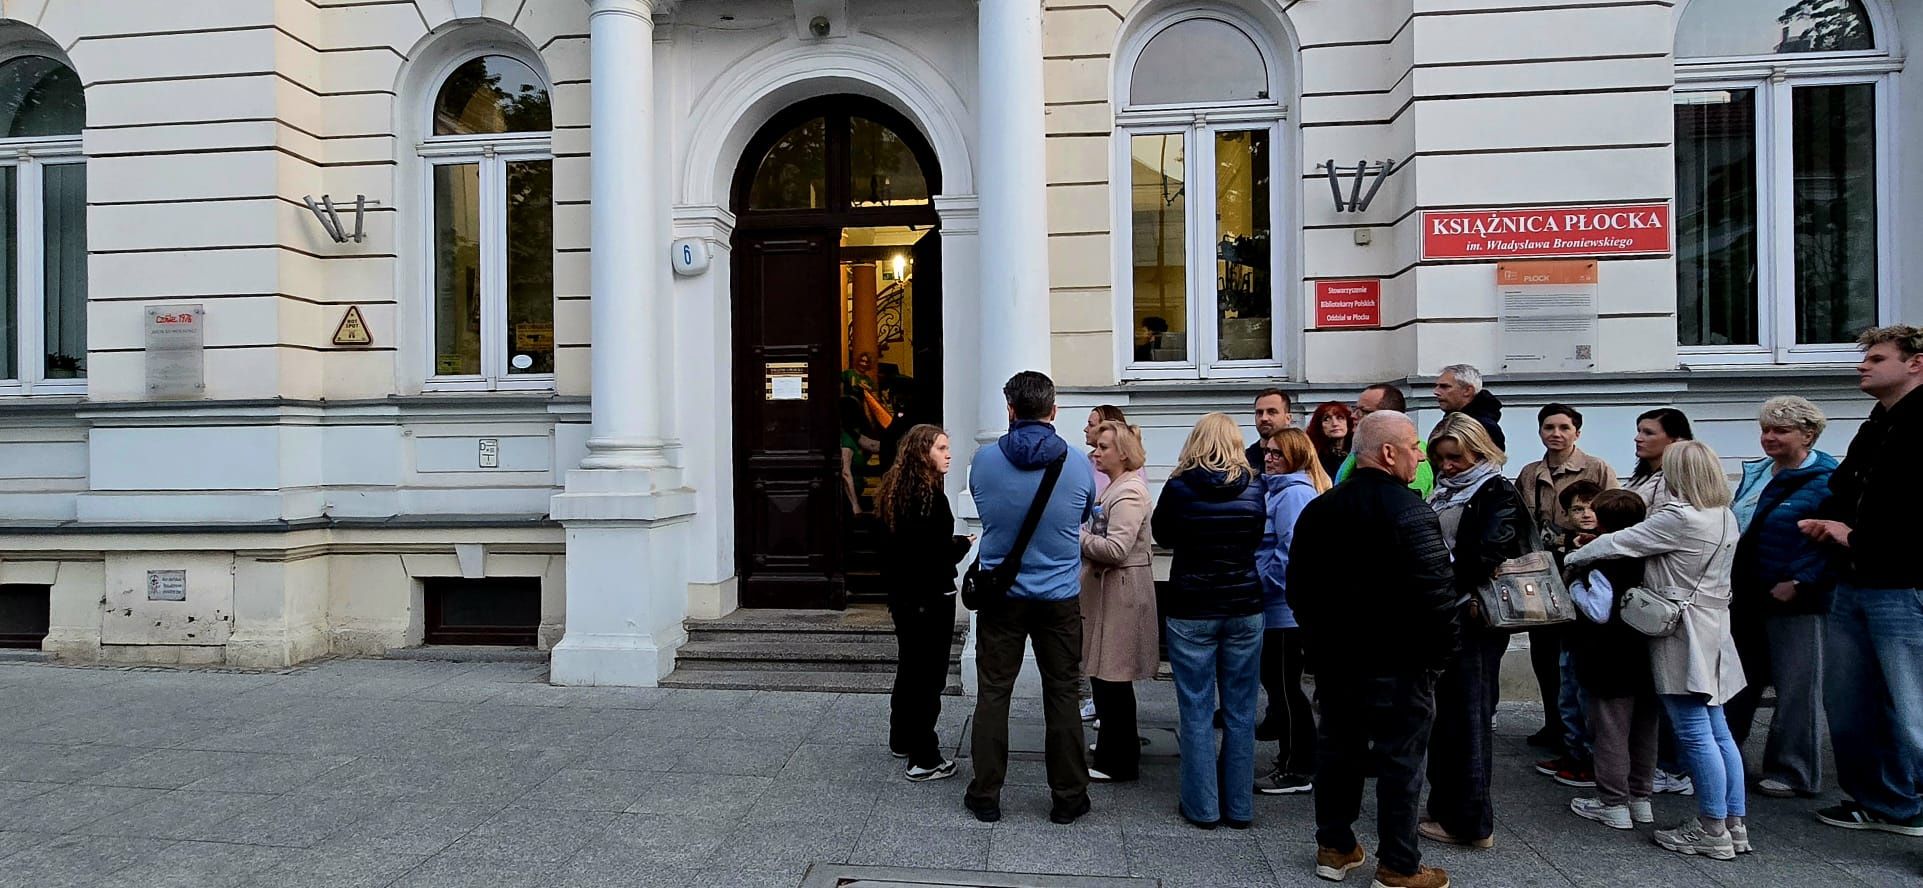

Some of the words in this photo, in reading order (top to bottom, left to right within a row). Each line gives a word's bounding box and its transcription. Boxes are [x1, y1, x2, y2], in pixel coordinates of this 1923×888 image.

[1432, 213, 1560, 238] KSIĄŻNICA
[1565, 211, 1663, 231] PŁOCKA
[1466, 240, 1483, 251] im.
[1486, 238, 1550, 252] Władysława
[1553, 236, 1634, 250] Broniewskiego
[683, 244, 692, 265] 6
[1328, 286, 1367, 294] Stowarzyszenie
